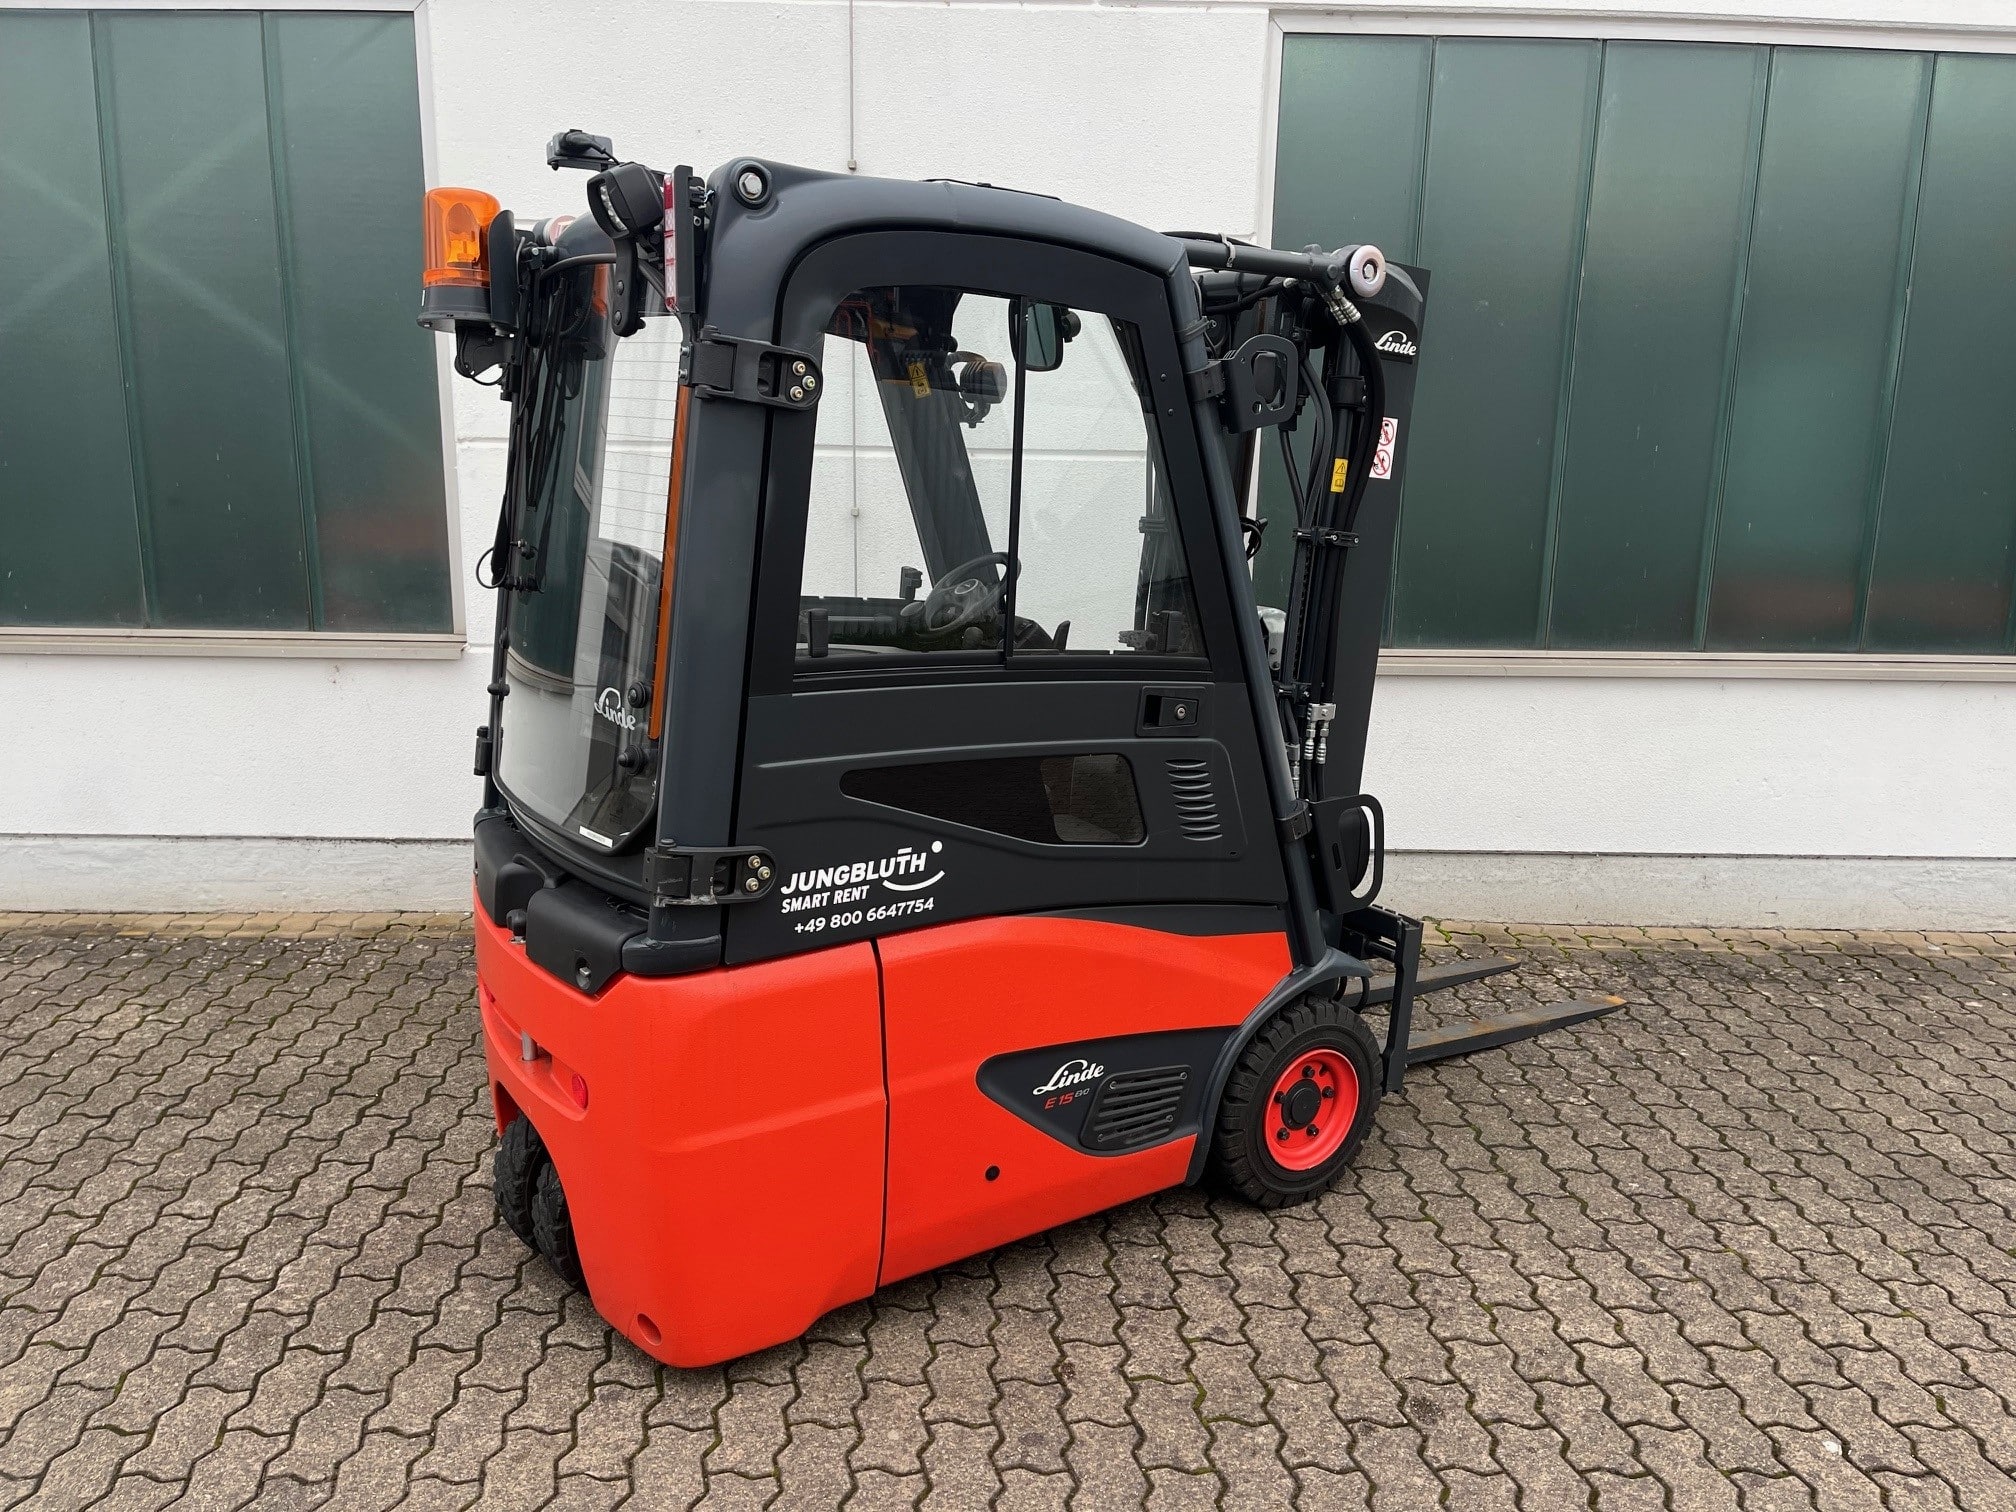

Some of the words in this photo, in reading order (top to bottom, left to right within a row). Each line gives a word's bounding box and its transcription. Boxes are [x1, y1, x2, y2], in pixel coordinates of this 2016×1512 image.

[1374, 331, 1416, 355] Linde
[594, 687, 635, 730] Linde
[780, 847, 927, 894] JUNGBLUTH
[781, 891, 831, 914] SMART
[833, 885, 870, 905] RENT
[794, 917, 826, 934] +49
[829, 911, 862, 929] 800
[866, 897, 935, 922] 6647754
[1032, 1059, 1105, 1095] Linde
